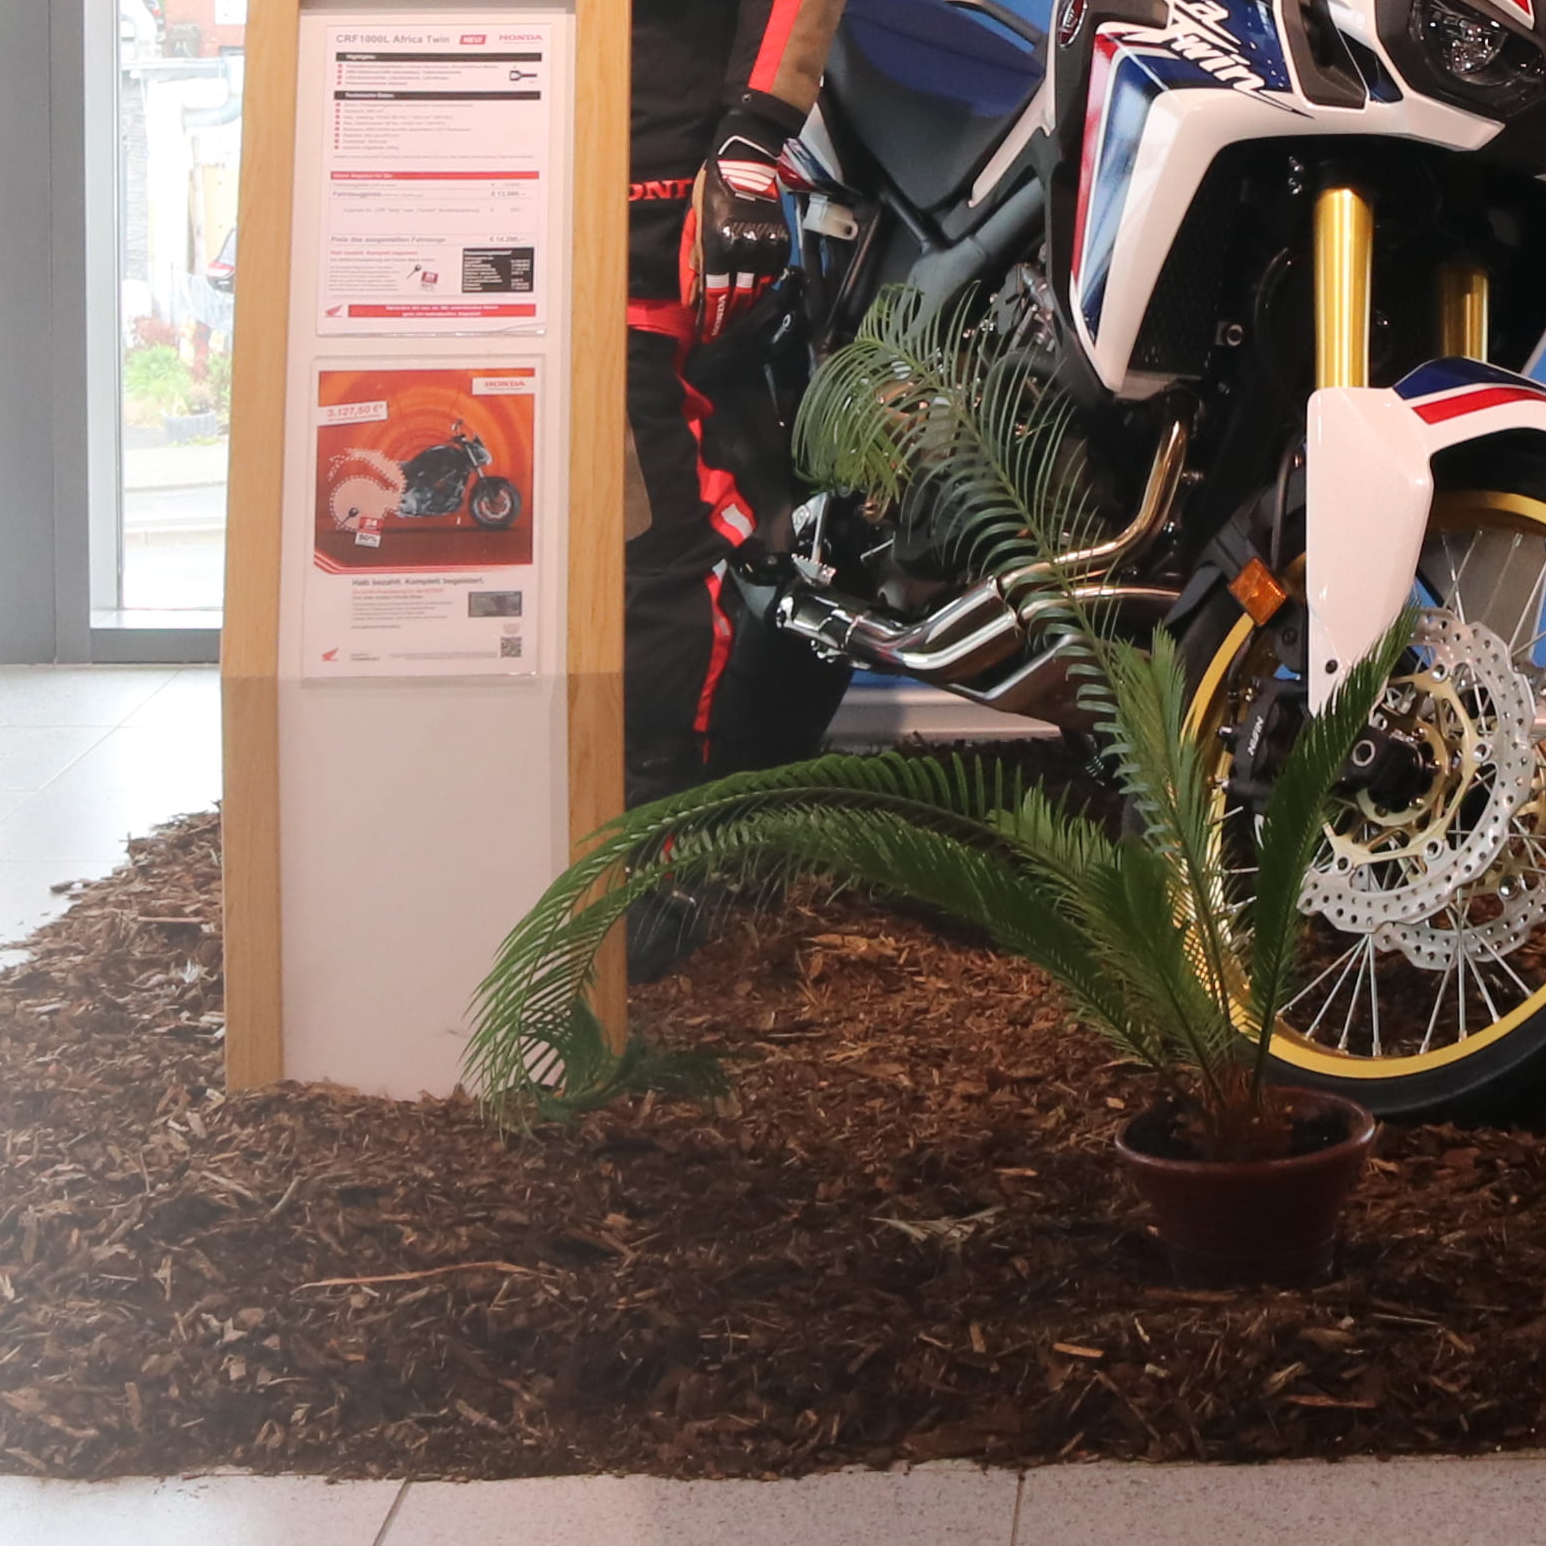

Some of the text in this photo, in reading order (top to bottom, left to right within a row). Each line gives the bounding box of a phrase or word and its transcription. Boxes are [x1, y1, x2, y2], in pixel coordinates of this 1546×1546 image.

[336, 34, 390, 44] CRF1000L
[392, 34, 423, 44] Africa
[427, 34, 450, 44] Twin
